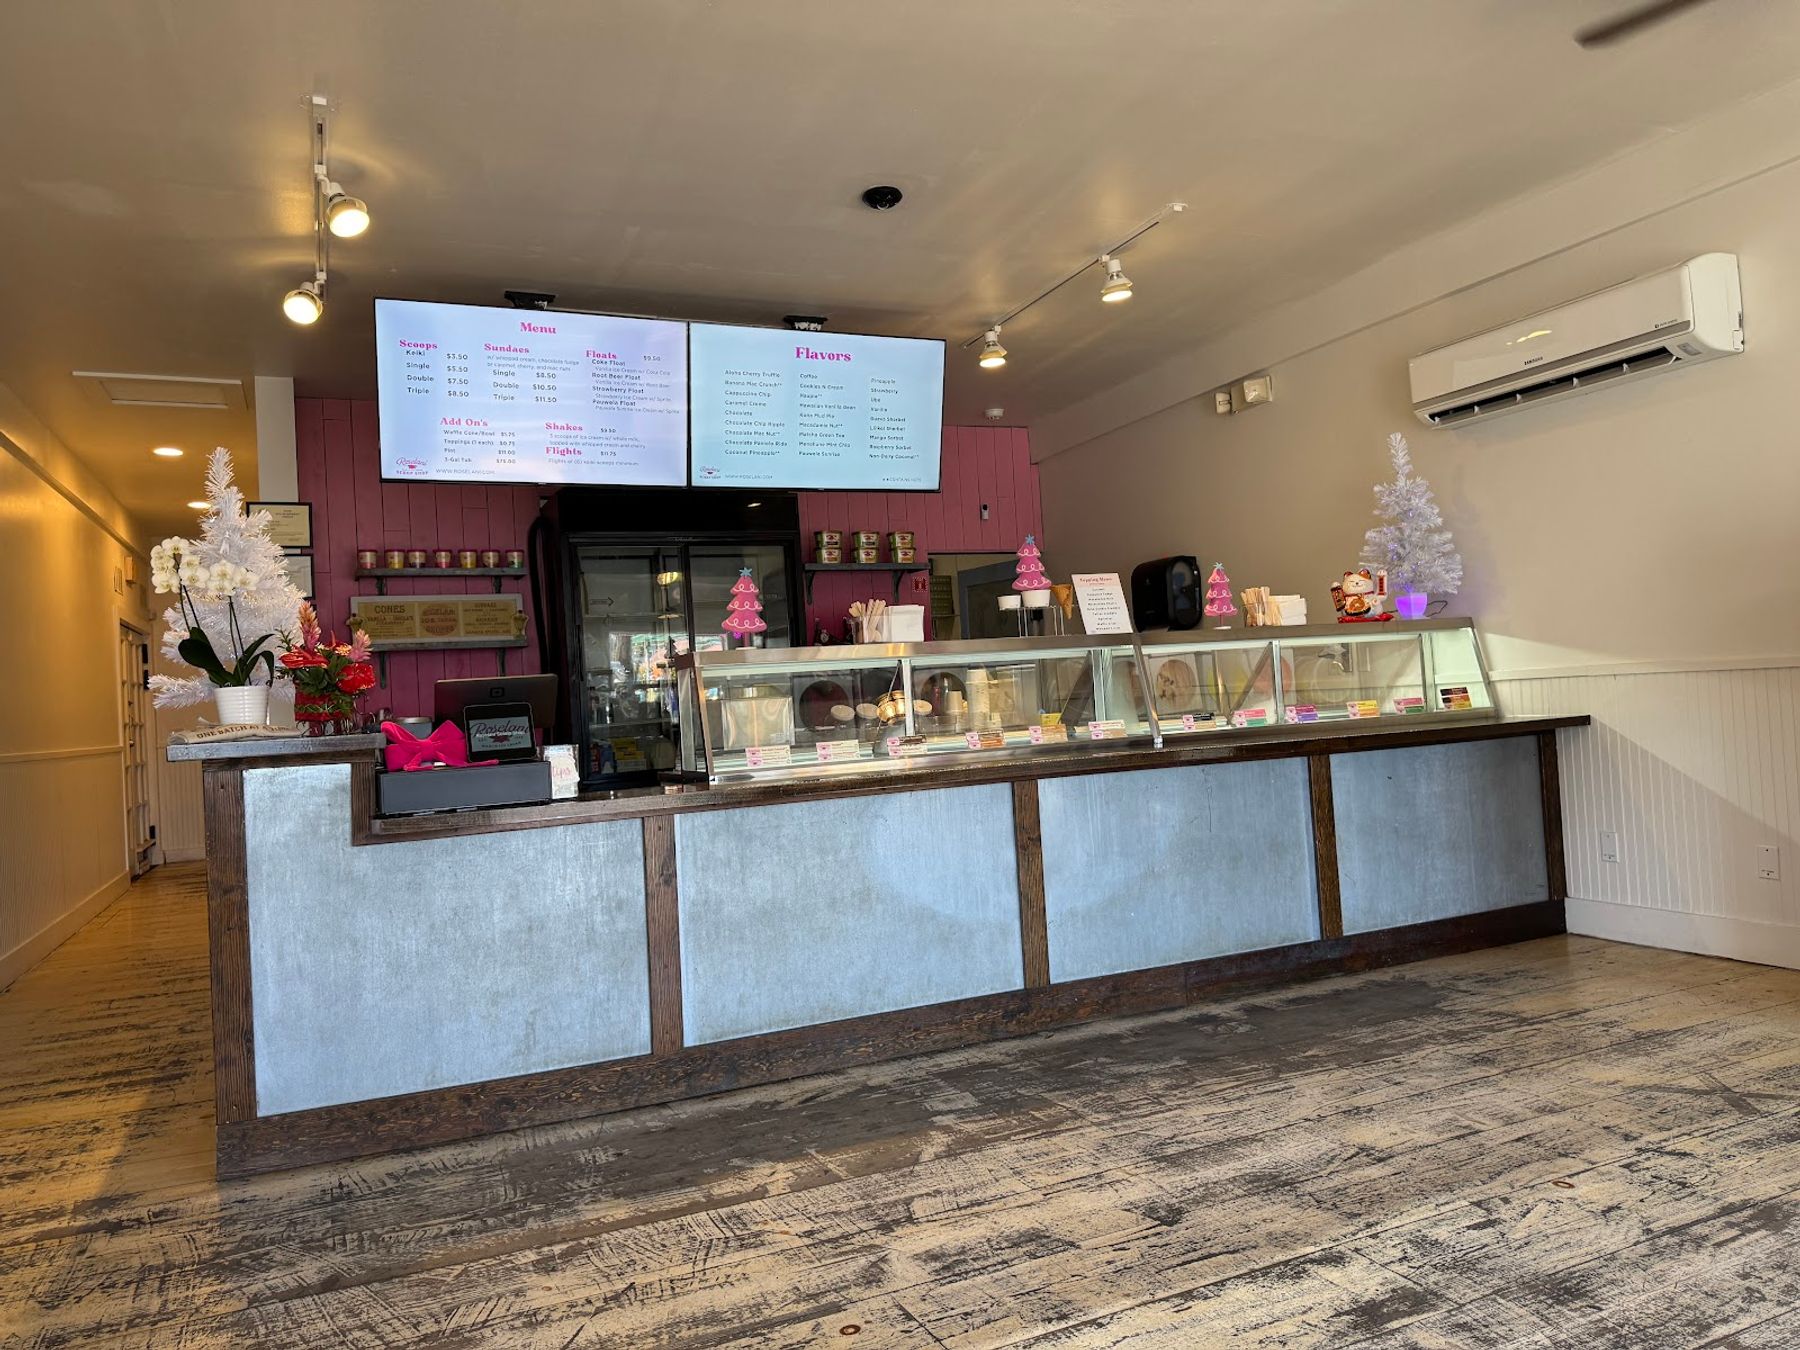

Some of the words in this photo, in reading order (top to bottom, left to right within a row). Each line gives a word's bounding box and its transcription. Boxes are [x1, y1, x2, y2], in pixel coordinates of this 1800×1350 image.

[520, 322, 557, 334] Menu
[399, 340, 438, 350] Scoops
[484, 343, 530, 353] Sundaes
[586, 350, 617, 360] Floats
[796, 346, 851, 362] Flavors
[440, 417, 462, 426] Add
[466, 418, 488, 427] On's
[545, 422, 583, 432] Shakes
[546, 447, 582, 456] Flights
[375, 605, 406, 614] CONES
[218, 726, 247, 735] BATCH
[552, 766, 571, 778] tips
